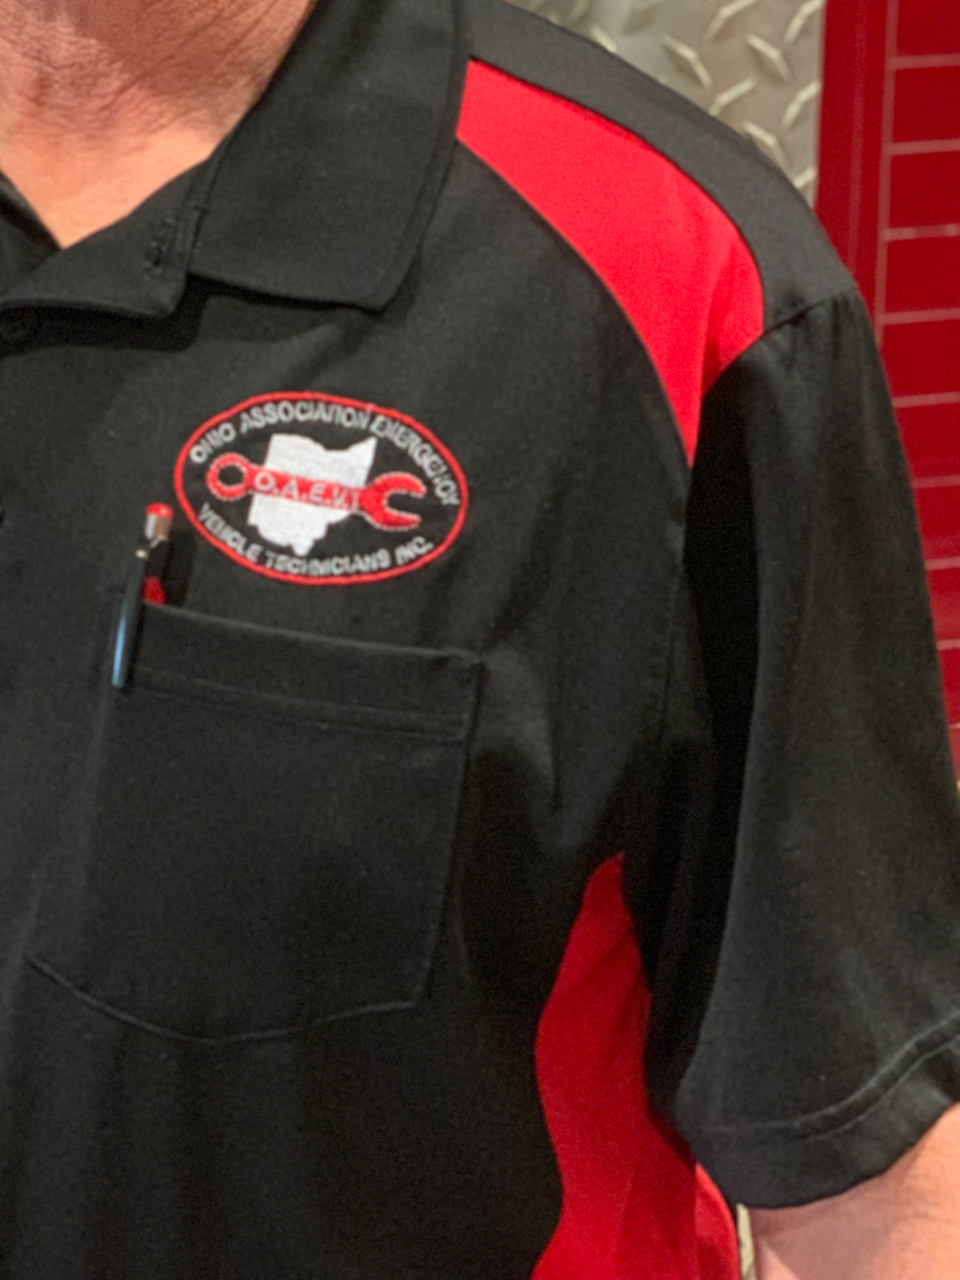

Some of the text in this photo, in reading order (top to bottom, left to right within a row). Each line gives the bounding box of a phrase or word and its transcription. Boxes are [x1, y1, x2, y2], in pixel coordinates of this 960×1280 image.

[189, 400, 460, 505] OHIO ASSOCIATION EMERGENCY
[198, 502, 263, 562] VEHICLE
[265, 548, 390, 576] TECHNICIANS
